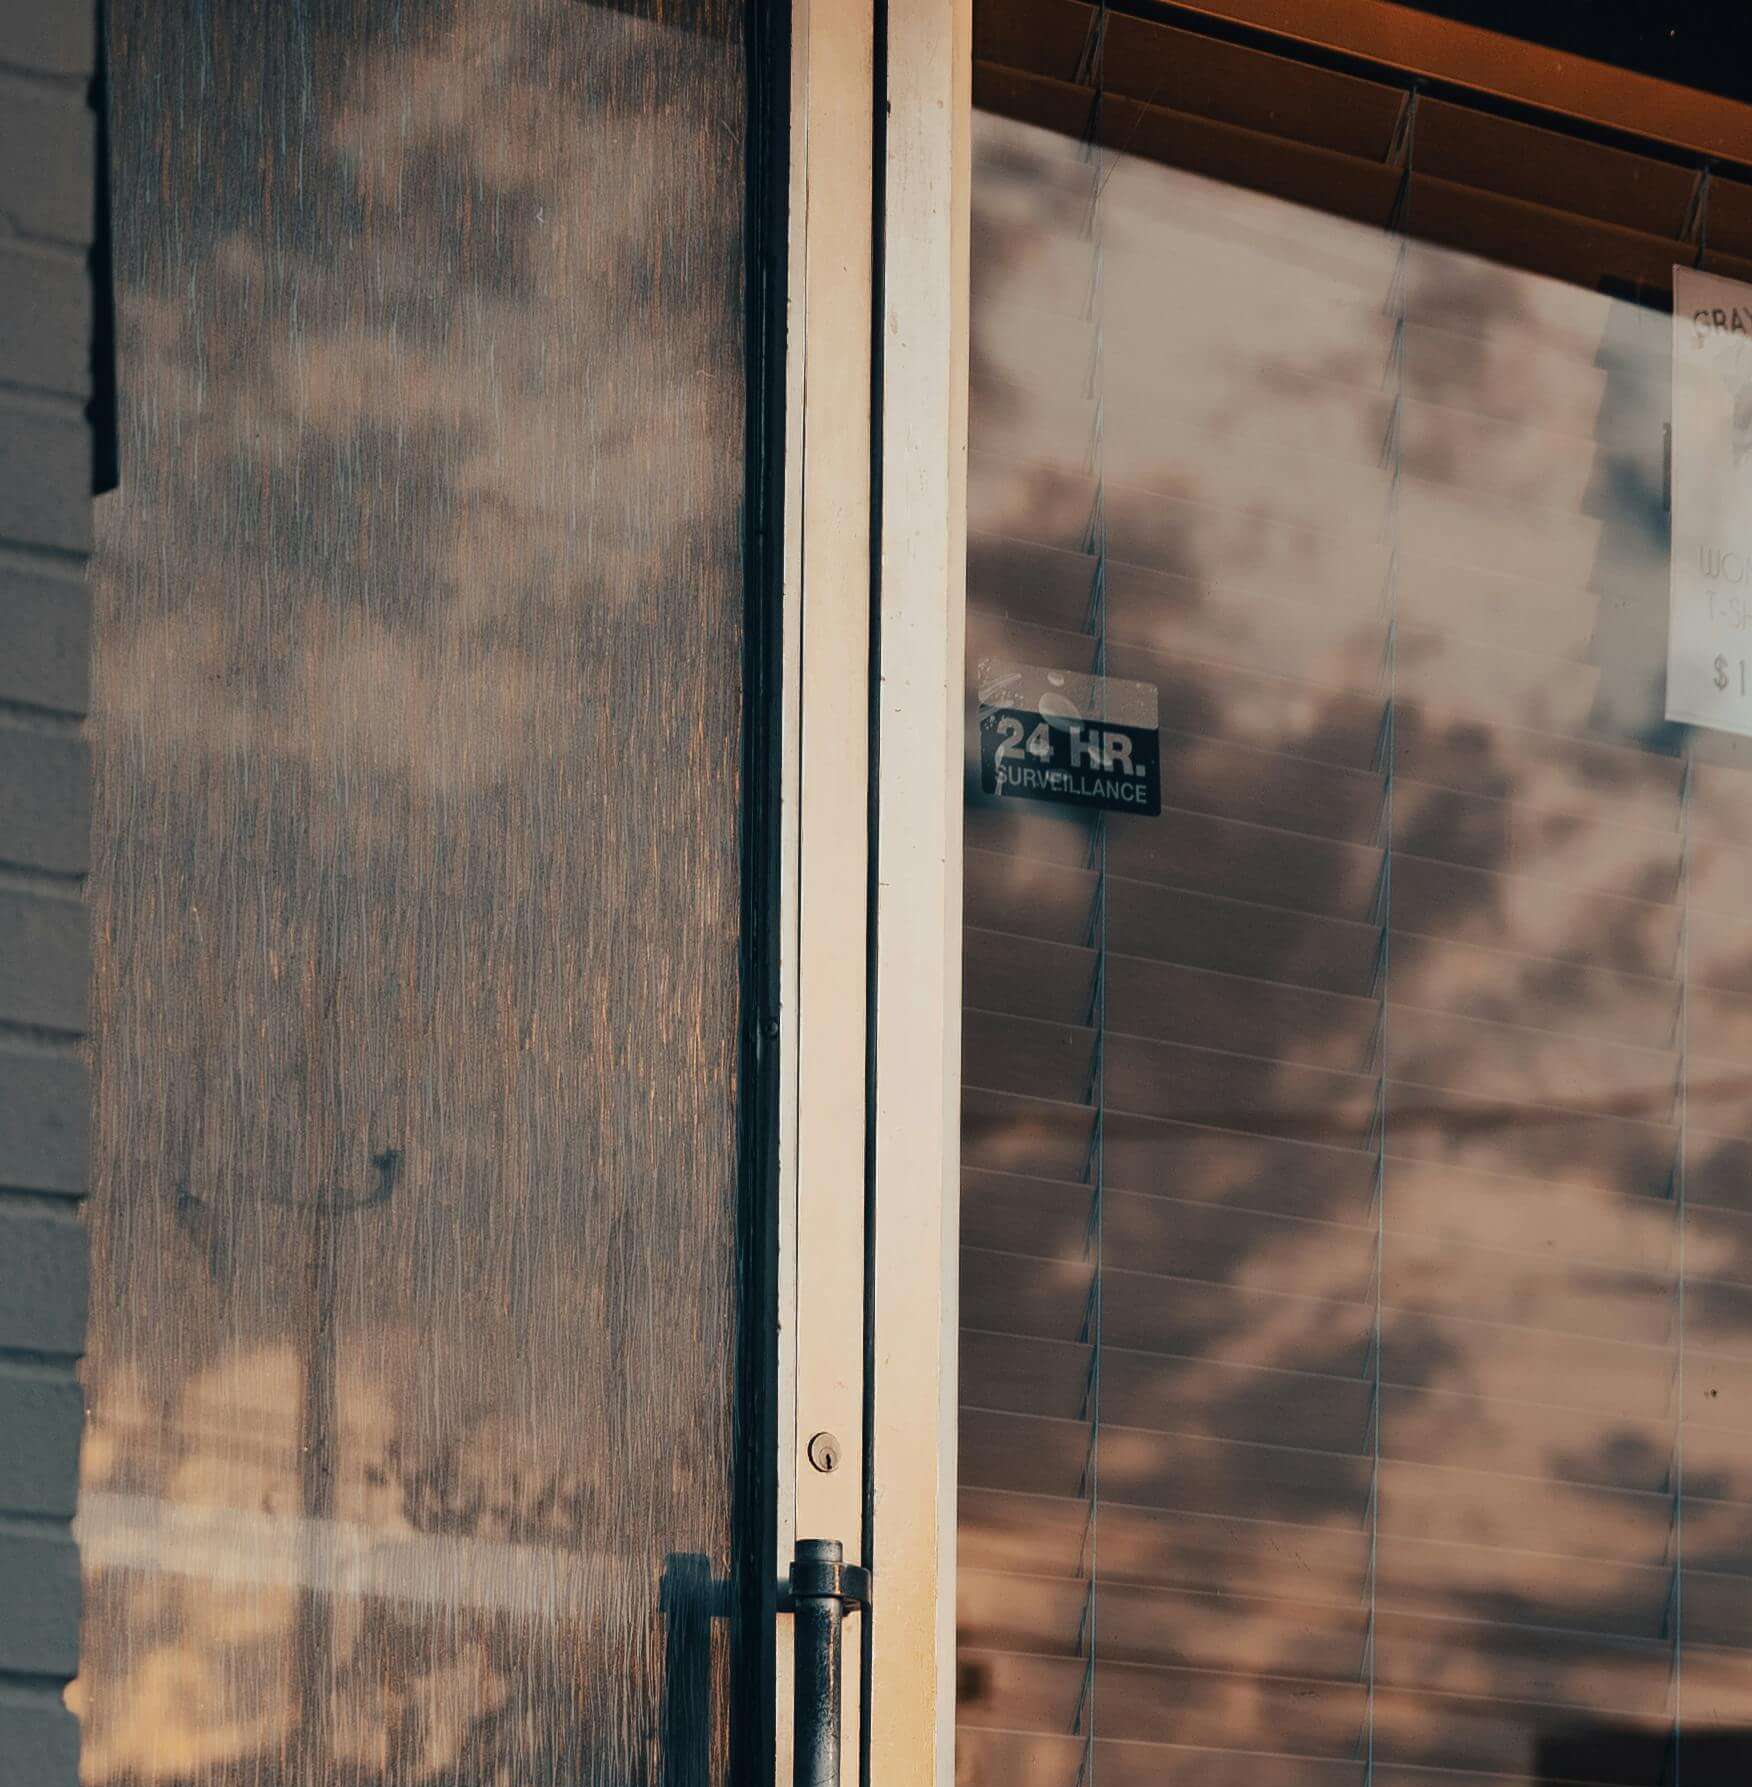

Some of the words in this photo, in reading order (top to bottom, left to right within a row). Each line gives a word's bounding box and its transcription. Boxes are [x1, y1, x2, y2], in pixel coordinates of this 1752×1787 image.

[996, 717, 1054, 763] 24
[1069, 725, 1147, 777] HR.
[996, 764, 1148, 804] SURVEILLANCE
